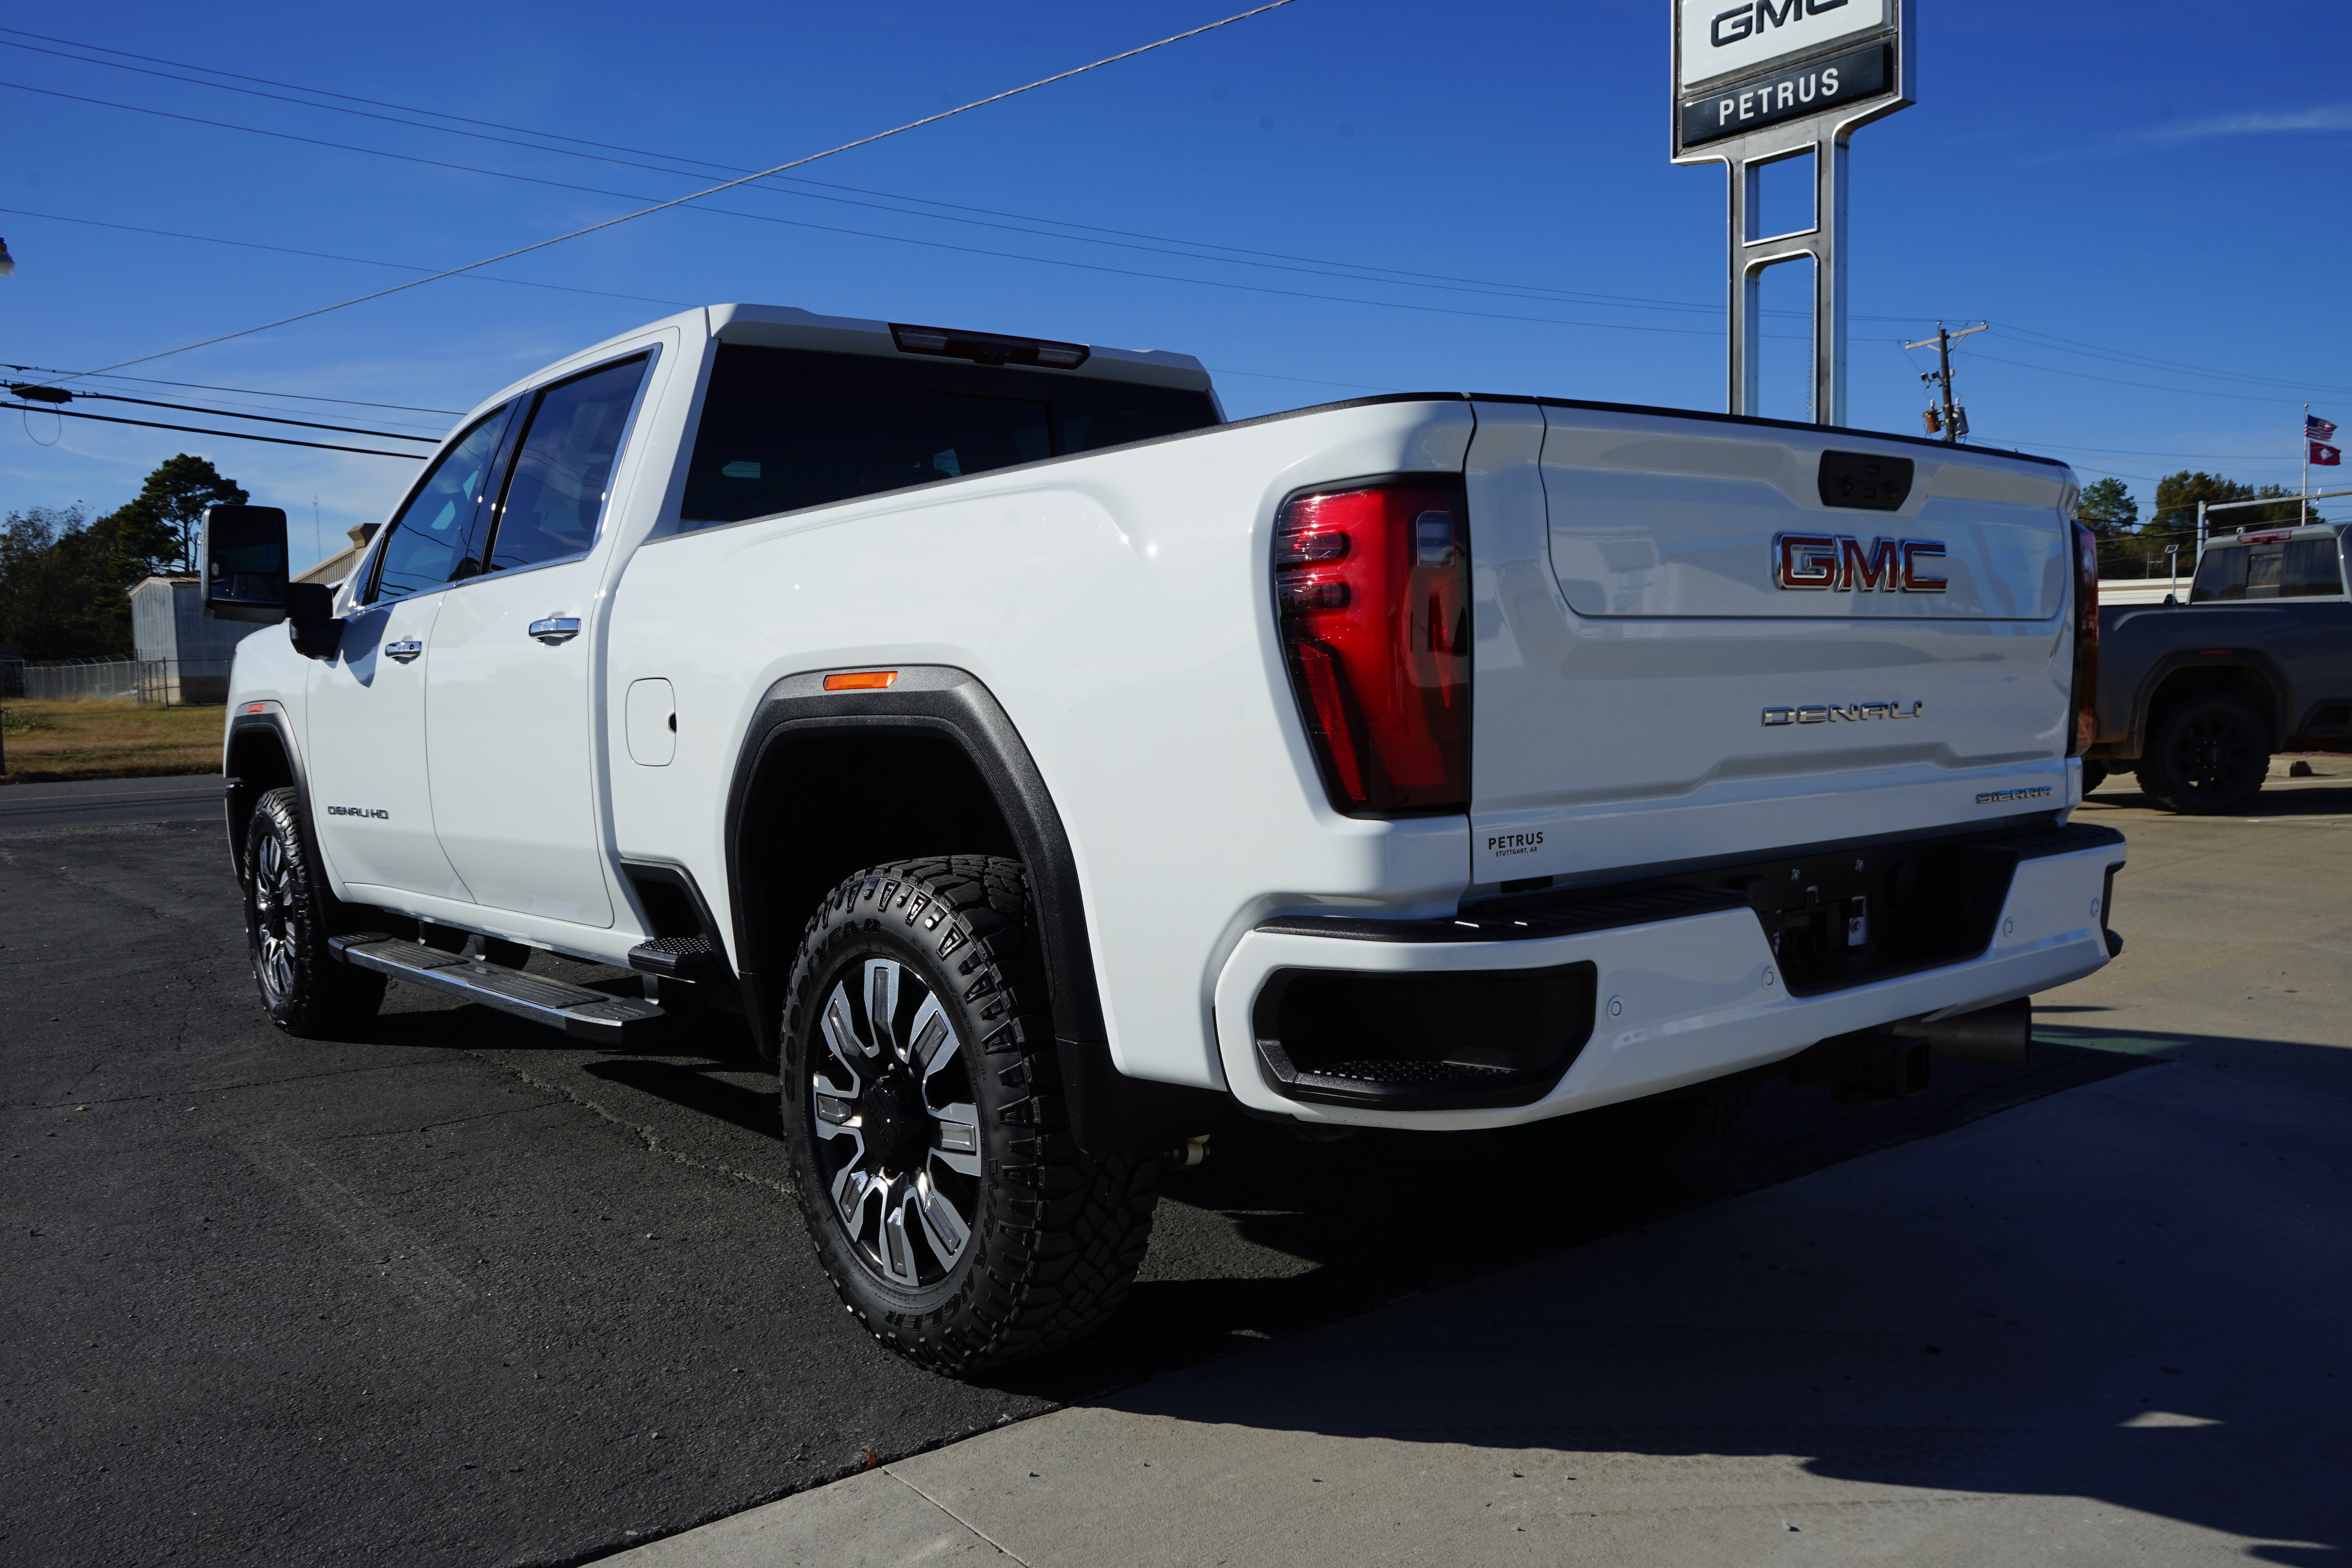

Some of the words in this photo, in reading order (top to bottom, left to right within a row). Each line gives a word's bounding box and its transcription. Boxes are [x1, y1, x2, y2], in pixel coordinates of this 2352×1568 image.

[1719, 67, 1839, 126] PETRUS
[1772, 531, 1948, 592] GMC
[1762, 700, 1922, 726] DENALI
[1976, 785, 2053, 804] SIERRA
[328, 806, 370, 818] DENALI
[370, 808, 389, 820] HD
[1488, 831, 1543, 850] PETRUS
[1495, 848, 1528, 857] STUTTGART,
[885, 1159, 998, 1332] WRANGLER
